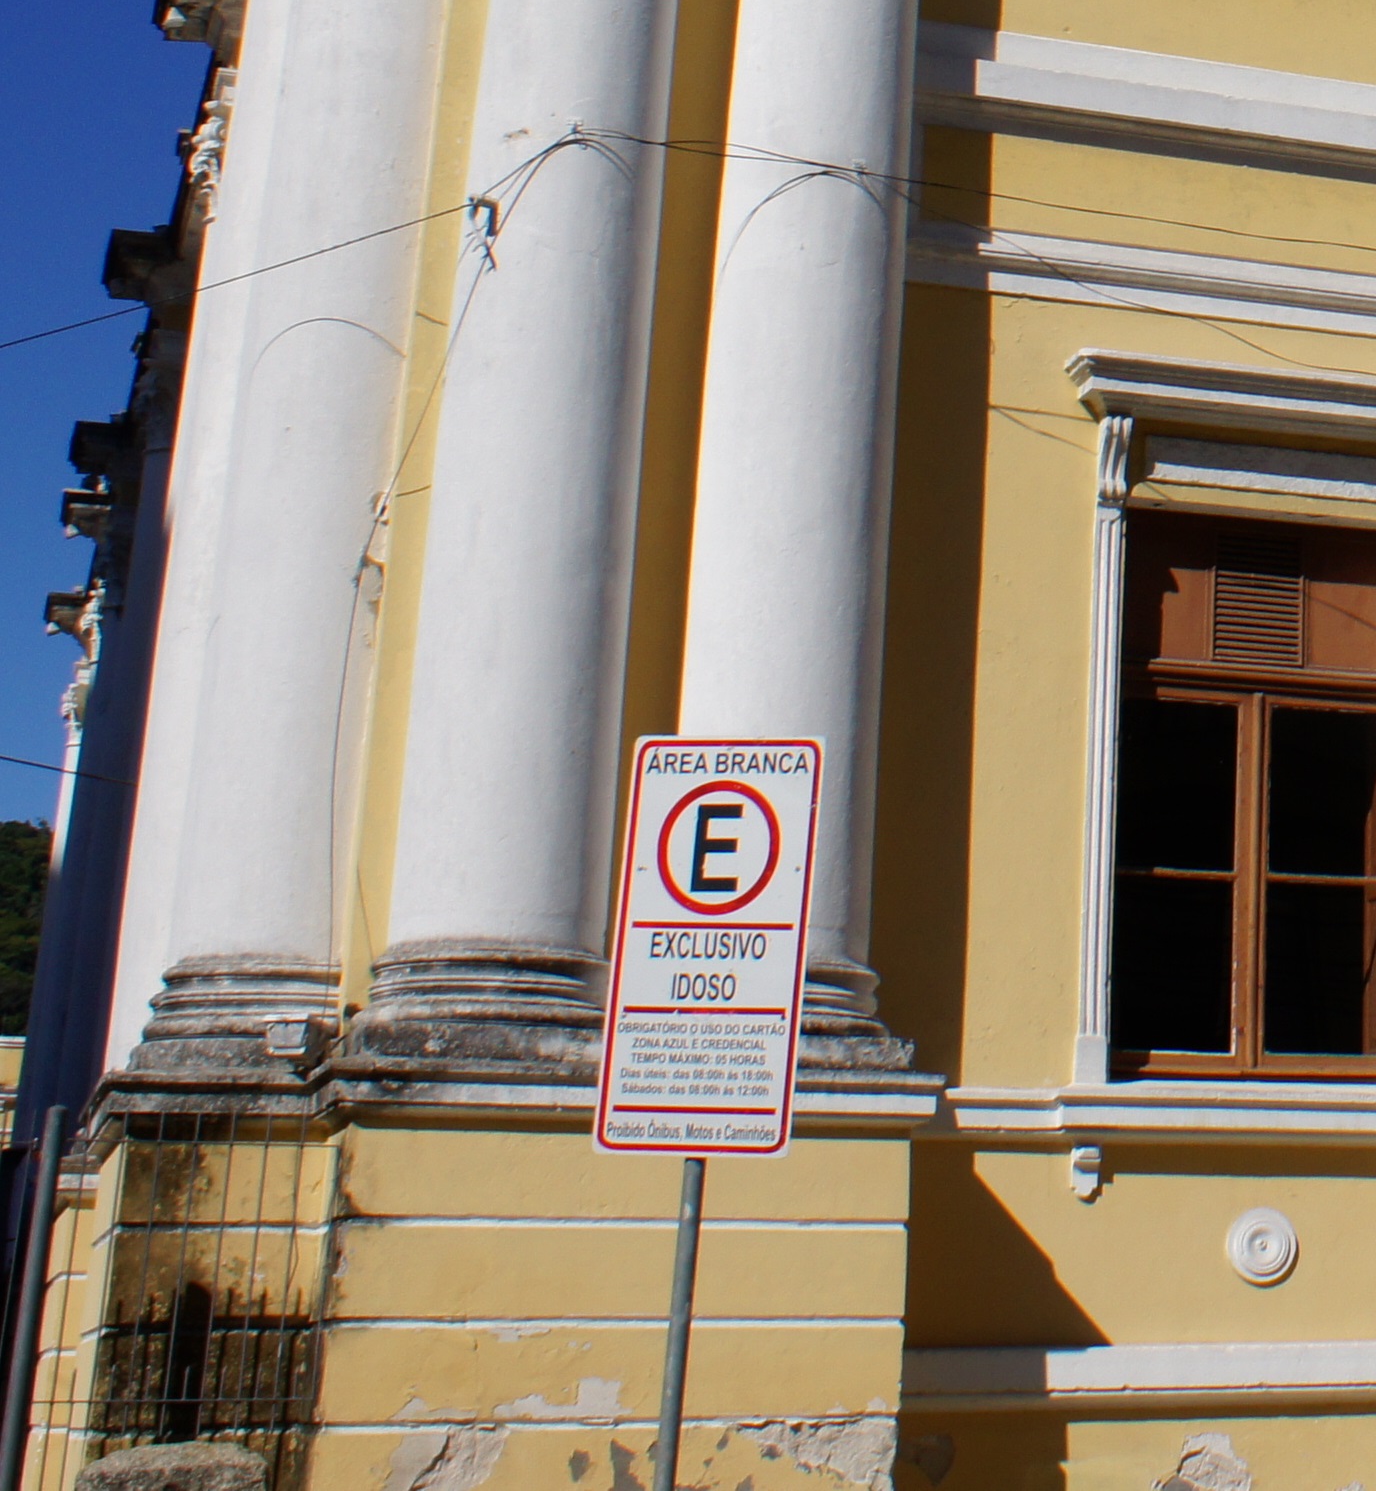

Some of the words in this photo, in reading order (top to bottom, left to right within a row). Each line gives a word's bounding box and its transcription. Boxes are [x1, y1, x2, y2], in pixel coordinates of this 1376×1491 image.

[646, 748, 708, 774] ÁREA
[714, 752, 809, 774] BRANCA
[690, 804, 744, 892] E
[649, 932, 767, 959] EXCLUSIVO
[670, 973, 736, 1000] IDOSO
[618, 1022, 687, 1034] OBRIGATÓRIO
[690, 1023, 698, 1034] O
[701, 1024, 722, 1035] USO
[725, 1024, 740, 1035] DO
[742, 1023, 786, 1036] CARTÃO
[632, 1038, 661, 1049] ZONA
[662, 1038, 688, 1049] AZUL
[692, 1039, 699, 1049] E
[701, 1039, 766, 1050] CREDENCIAL
[632, 1053, 666, 1063] TEMPO
[668, 1052, 713, 1065] MÁXIMO:
[715, 1055, 727, 1065] 05
[730, 1055, 765, 1065] HORAS
[620, 1068, 641, 1078] Dias
[644, 1067, 668, 1079] úteis:
[672, 1069, 689, 1079] das
[693, 1069, 725, 1080] 08:00h
[742, 1070, 773, 1081] 18:00h
[621, 1083, 666, 1094] Sábados:
[668, 1084, 685, 1094] das
[738, 1085, 769, 1096] 12:00h
[607, 1121, 645, 1135] Proibido
[685, 1122, 713, 1139] Motos
[716, 1127, 722, 1139] e
[724, 1123, 776, 1141] Caminhões
